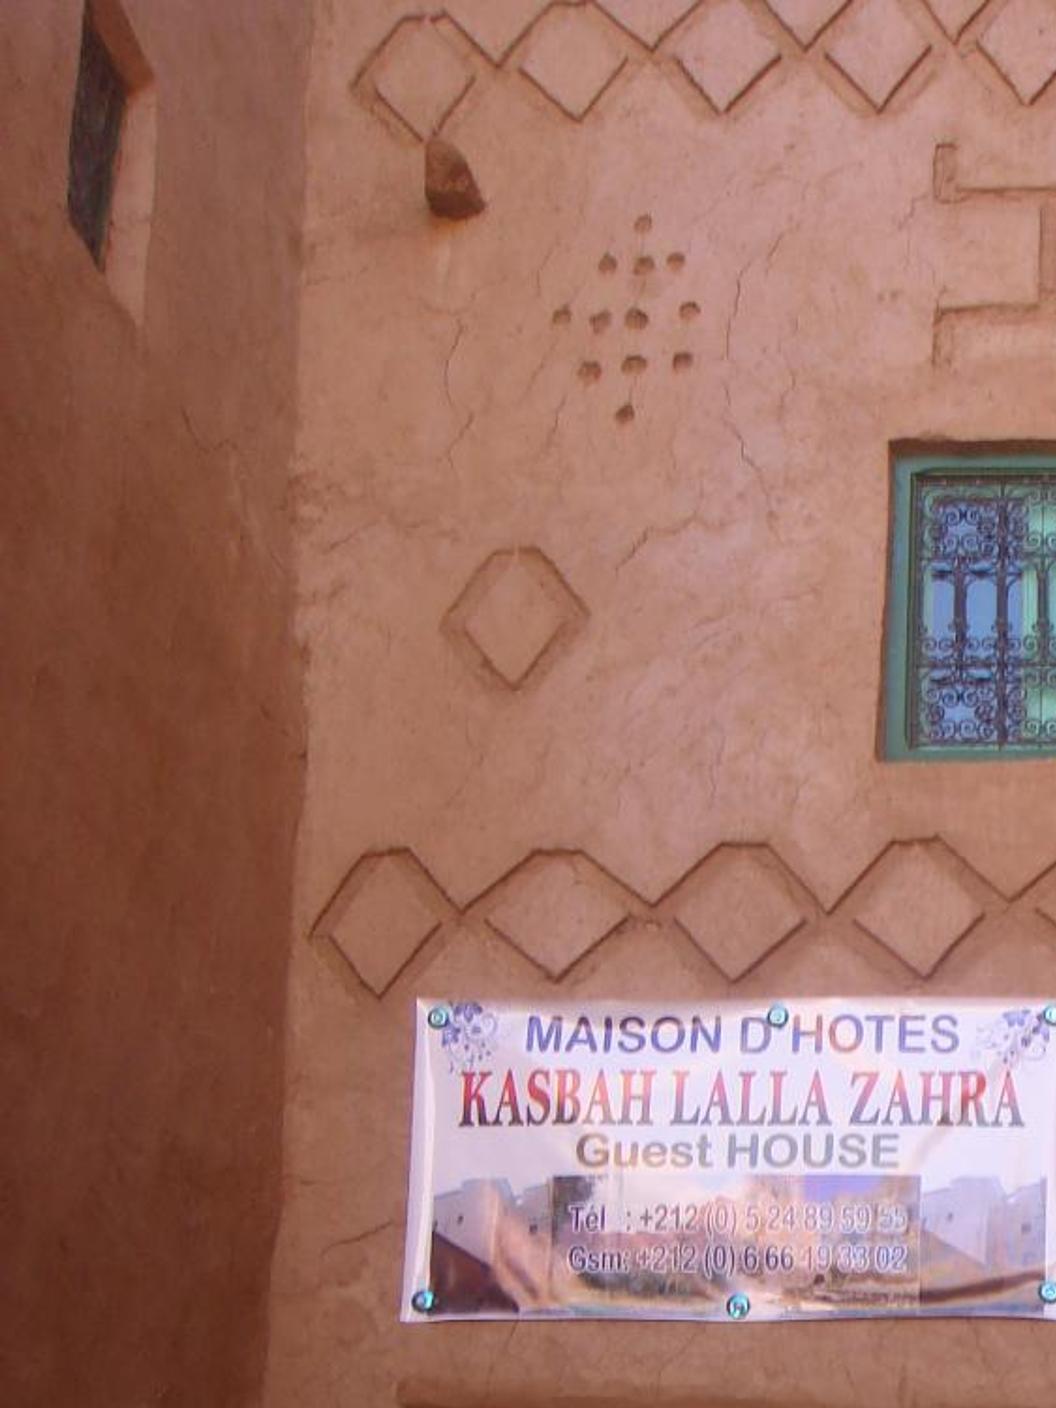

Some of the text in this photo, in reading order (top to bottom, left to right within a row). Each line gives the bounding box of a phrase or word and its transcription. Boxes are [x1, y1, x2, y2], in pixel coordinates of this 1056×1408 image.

[525, 1012, 960, 1054] MAISON DHOTES
[457, 1069, 1025, 1128] KASBAH LALLA ZAHRA
[575, 1132, 900, 1169] Guest HOUSE
[567, 1203, 607, 1233] Tél
[639, 1206, 699, 1232] +212
[705, 1204, 739, 1240] (0)
[746, 1206, 760, 1232] 5
[766, 1206, 796, 1232] 24
[804, 1206, 835, 1232] 89
[636, 1246, 698, 1275] +212
[704, 1246, 736, 1280] (0)
[743, 1246, 759, 1275] 6
[764, 1246, 794, 1274] 66
[874, 1246, 908, 1274] 02
